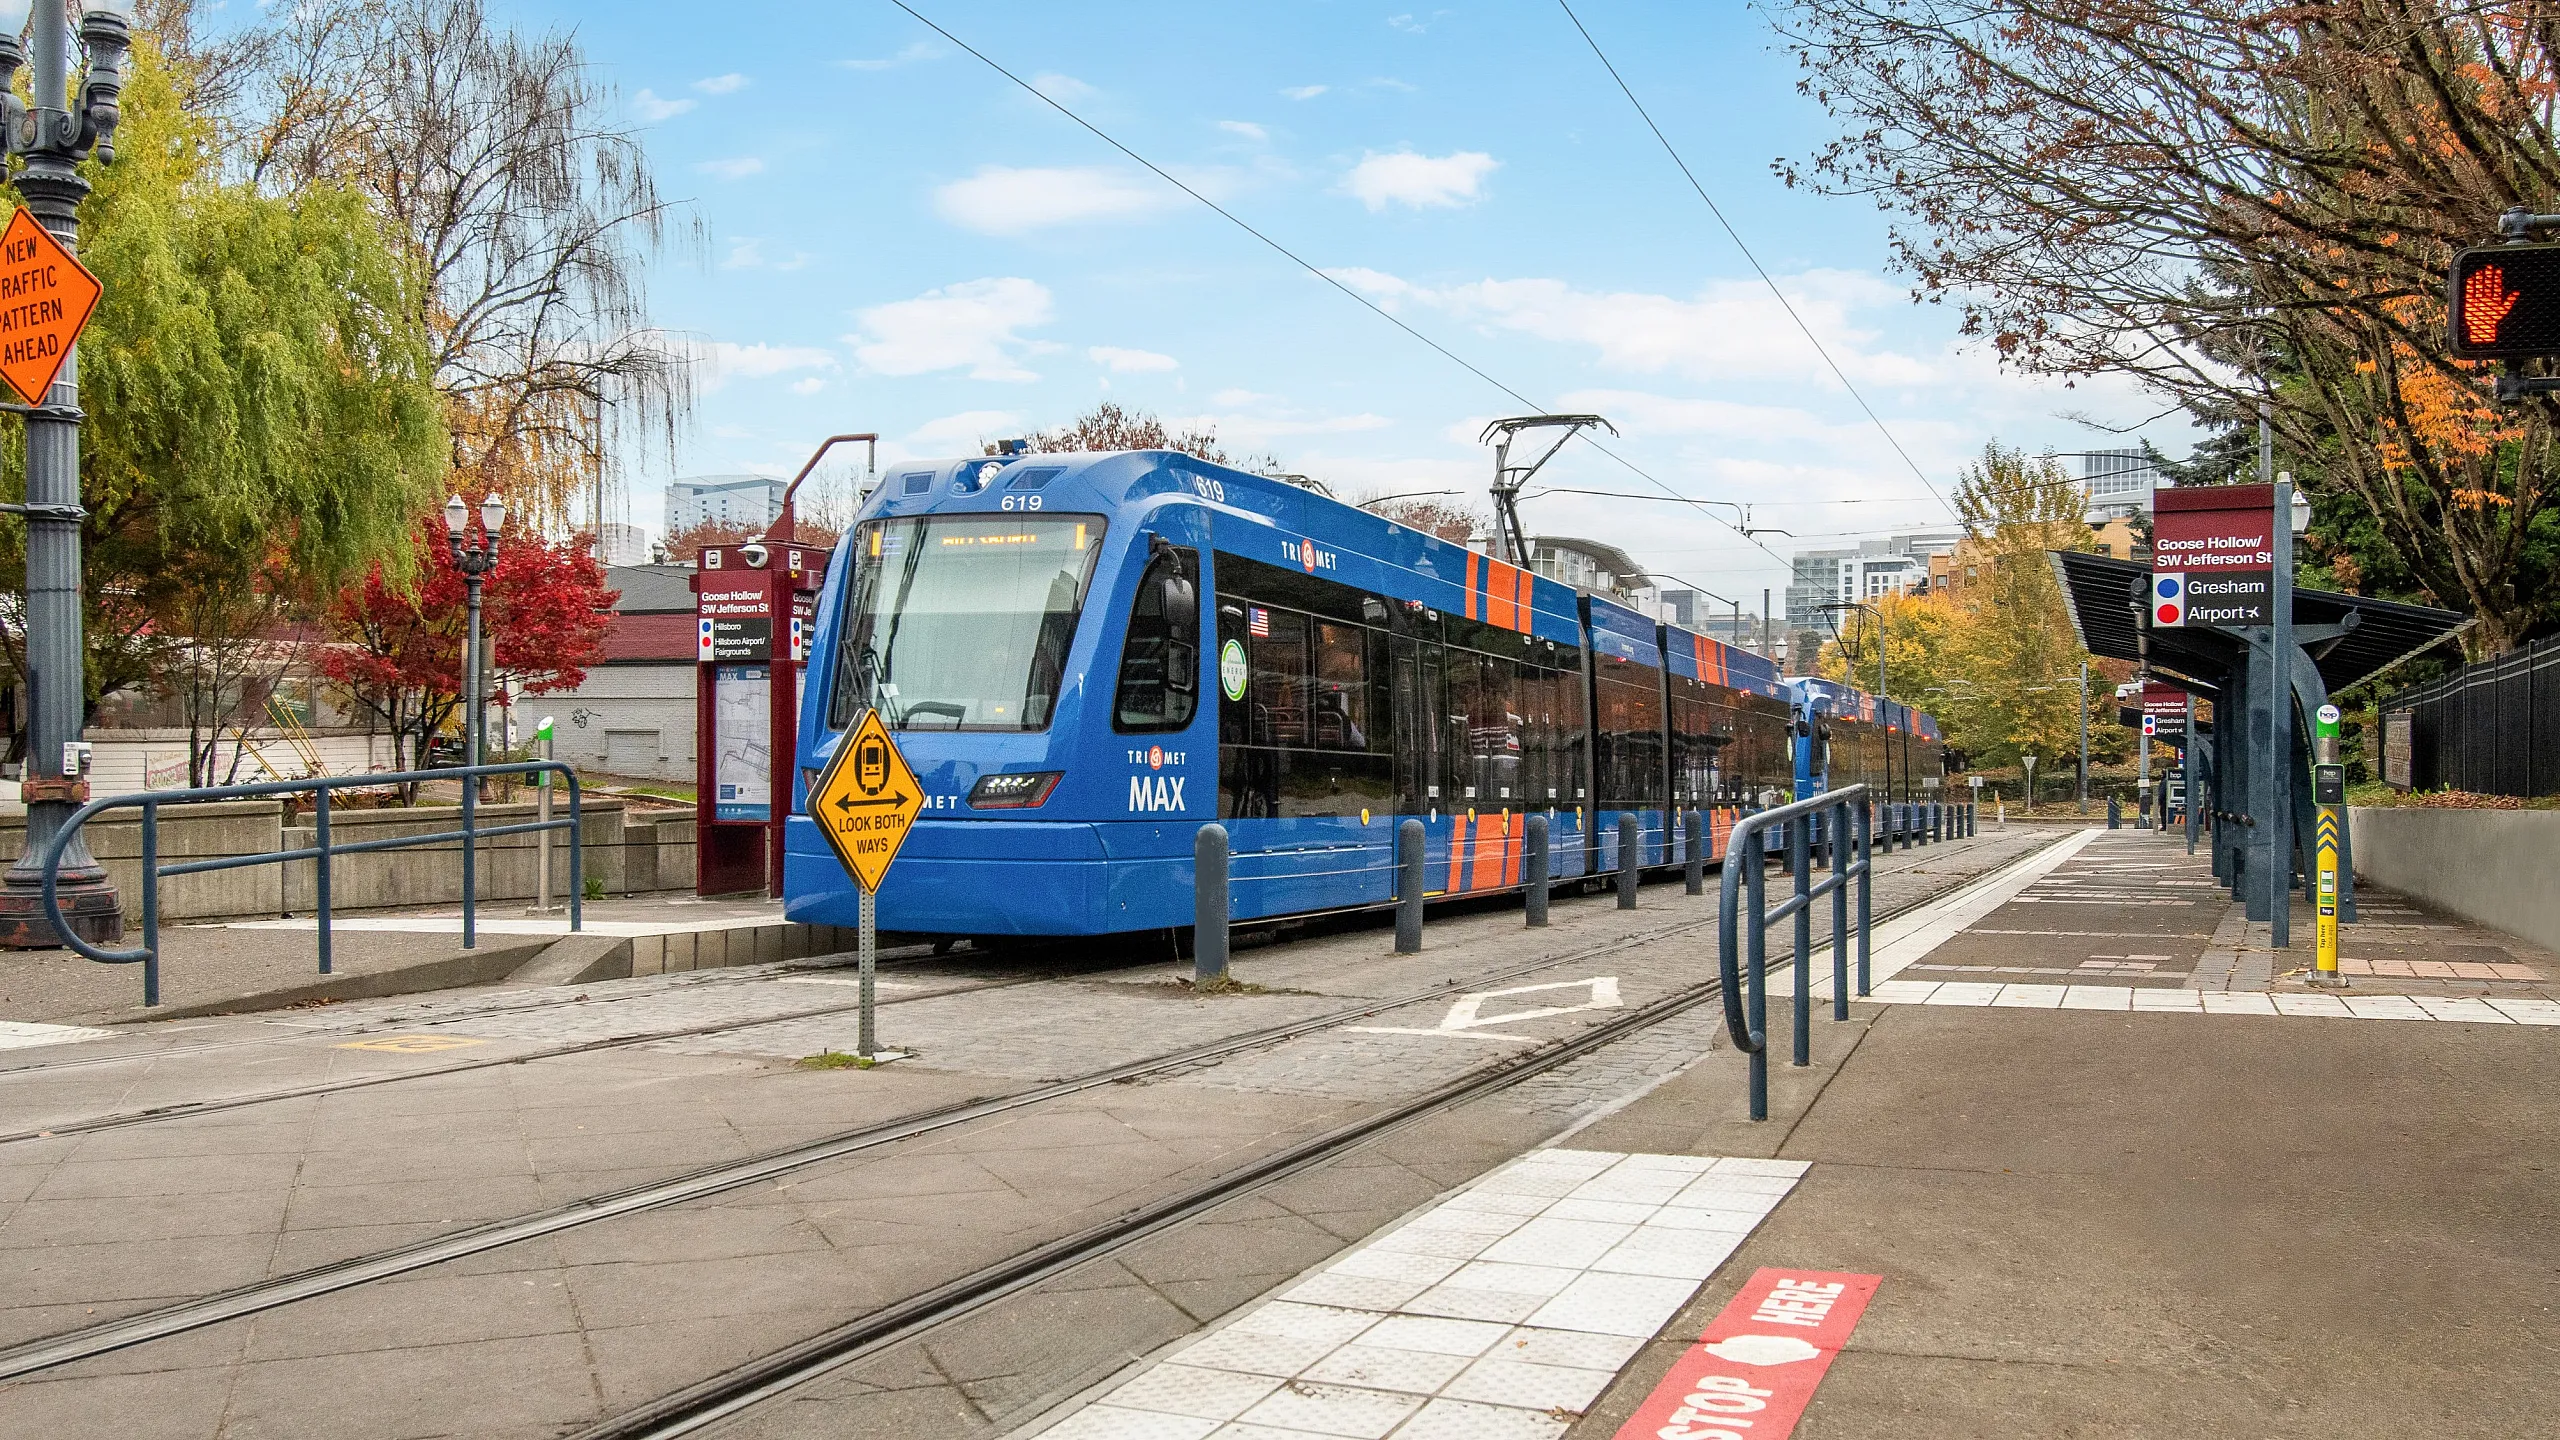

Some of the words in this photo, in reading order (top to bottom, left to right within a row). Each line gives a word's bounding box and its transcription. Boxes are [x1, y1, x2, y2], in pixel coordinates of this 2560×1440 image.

[6, 236, 37, 266] NEW
[1, 265, 57, 300] RAFFIC
[0, 298, 63, 333] ATTERN
[4, 333, 59, 366] AHEAD
[1196, 475, 1225, 503] 619
[1001, 495, 1042, 511] 619
[2157, 538, 2204, 551] Goose
[2207, 535, 2263, 550] Hollow/
[2157, 554, 2182, 567] SW
[2184, 552, 2253, 566] Jefferson
[2255, 551, 2273, 564] St
[2188, 580, 2265, 595] Gresham
[701, 591, 729, 602] Goose
[730, 590, 763, 601] Hollow/
[793, 593, 813, 604] Goose
[701, 604, 716, 614] SW
[717, 603, 757, 613] Jefferson
[758, 602, 769, 613] St
[793, 605, 803, 615] SW
[2188, 606, 2244, 623] Airport
[714, 623, 742, 631] Hillsboro
[802, 623, 815, 632] Hillsb
[714, 637, 741, 646] Hillsboro
[741, 636, 766, 647] Airport/
[715, 648, 751, 657] Fairgrounds
[719, 672, 738, 681] MAX
[2319, 711, 2338, 719] hop
[2323, 769, 2336, 778] hop
[1128, 775, 1186, 812] MAX
[839, 816, 871, 833] LOOK
[875, 813, 905, 831] BOTH
[856, 837, 888, 855] WAYS
[1656, 1375, 1774, 1440] STOP
[1751, 1278, 1845, 1328] HERE
